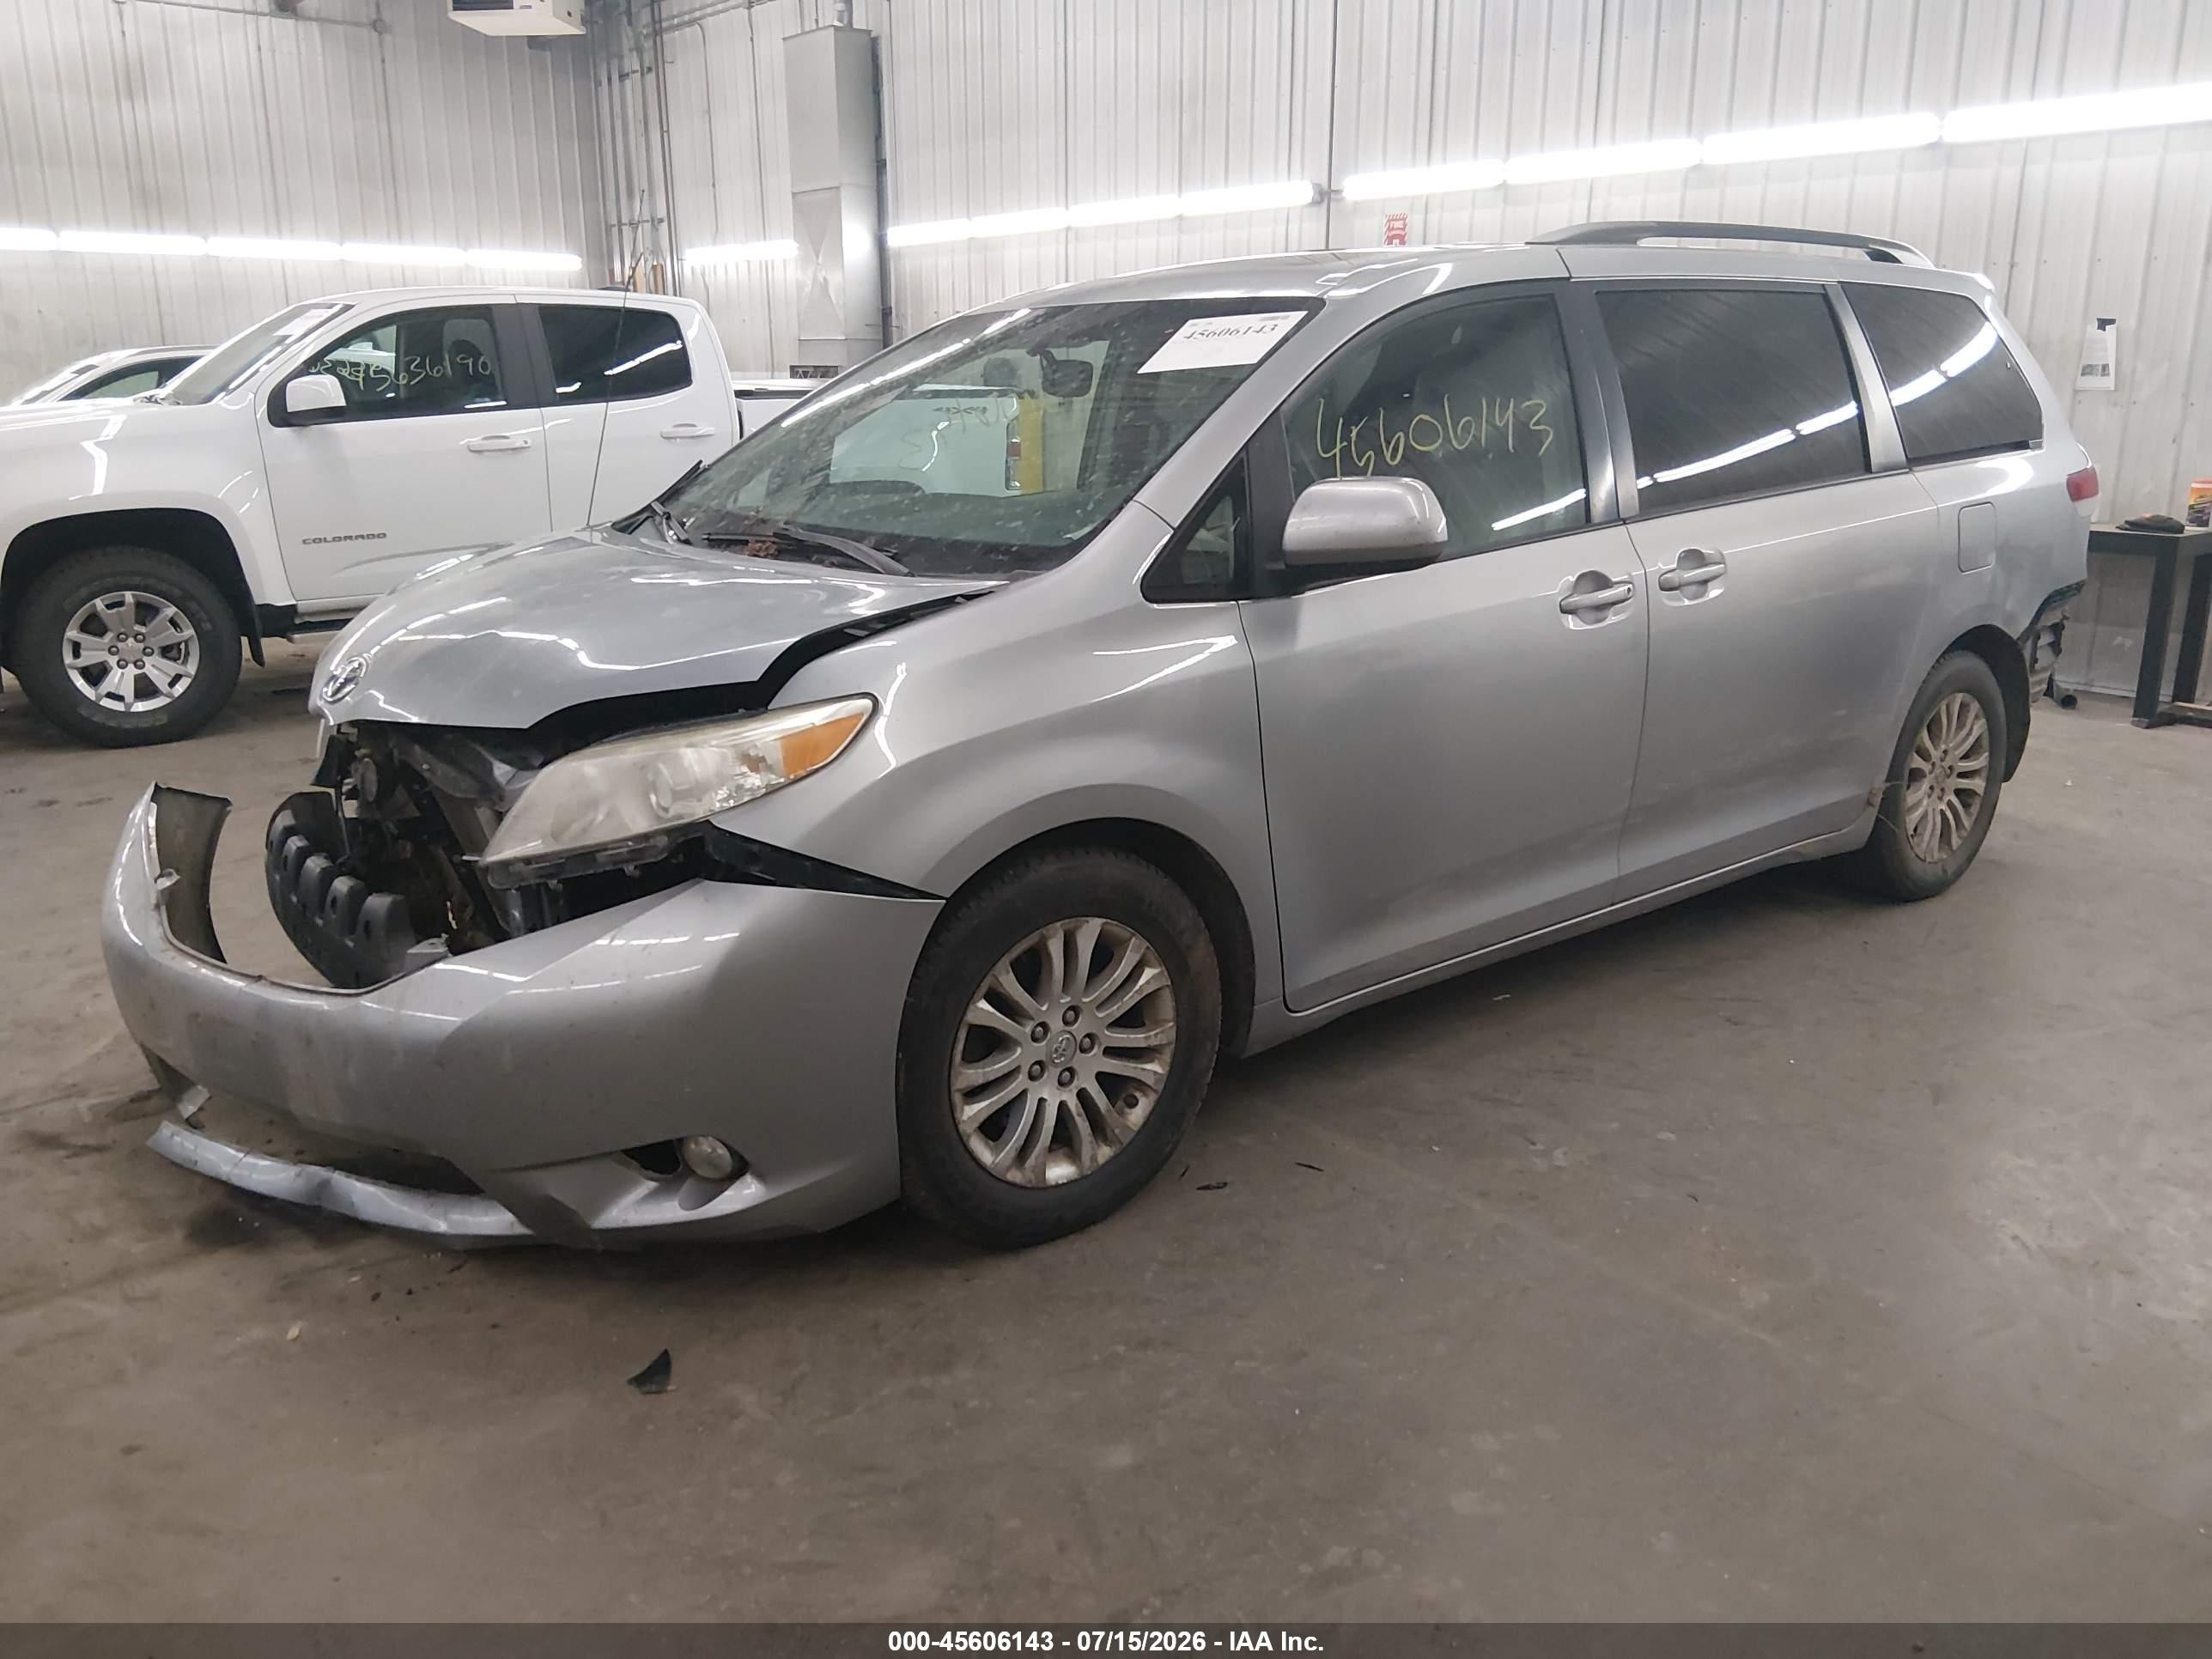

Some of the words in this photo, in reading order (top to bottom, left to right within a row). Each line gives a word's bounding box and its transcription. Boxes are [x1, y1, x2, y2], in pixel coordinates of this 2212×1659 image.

[1183, 324, 1279, 340] 45606143
[1316, 393, 1553, 480] 45606143
[301, 532, 386, 545] COLORADO
